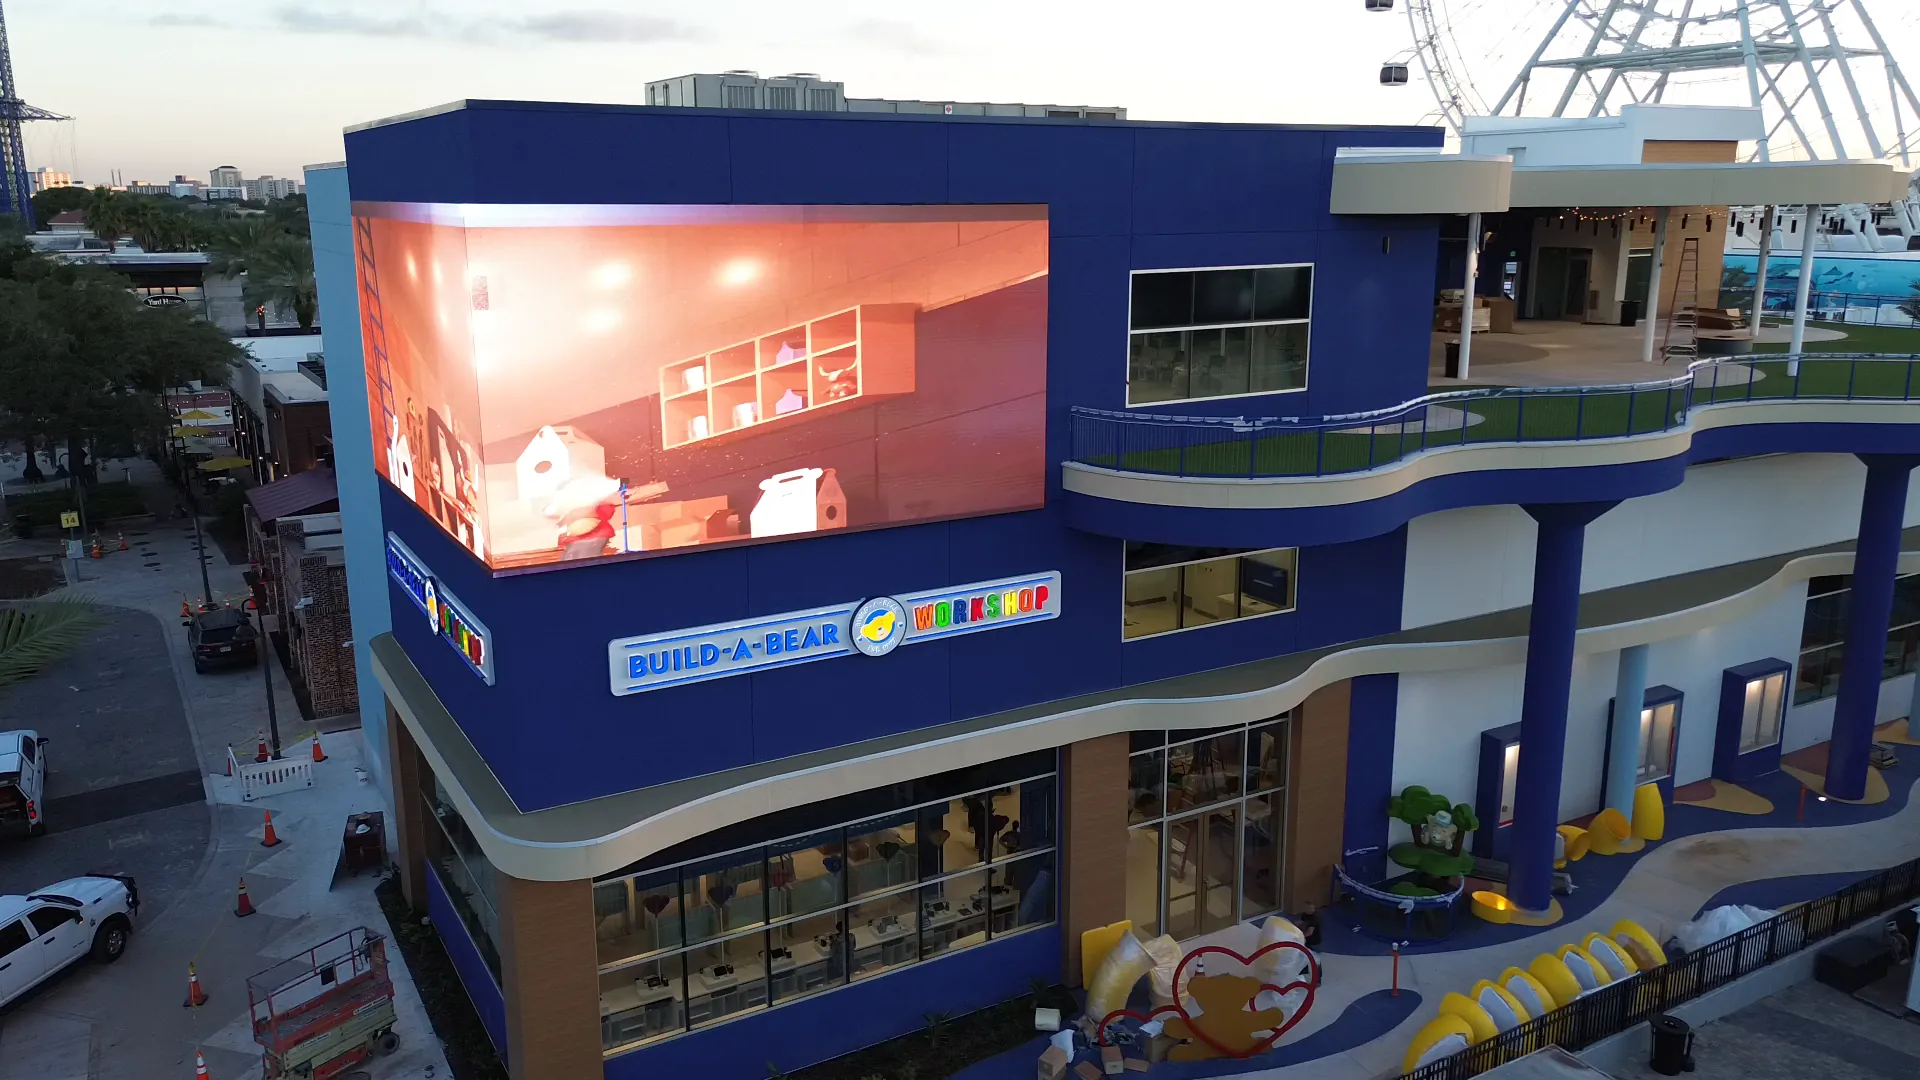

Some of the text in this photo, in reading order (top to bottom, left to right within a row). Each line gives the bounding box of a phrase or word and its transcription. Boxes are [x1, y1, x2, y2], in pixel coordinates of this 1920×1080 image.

[64, 517, 76, 525] 14
[628, 584, 1050, 680] BUILD-A-BEAR WORKSHOP
